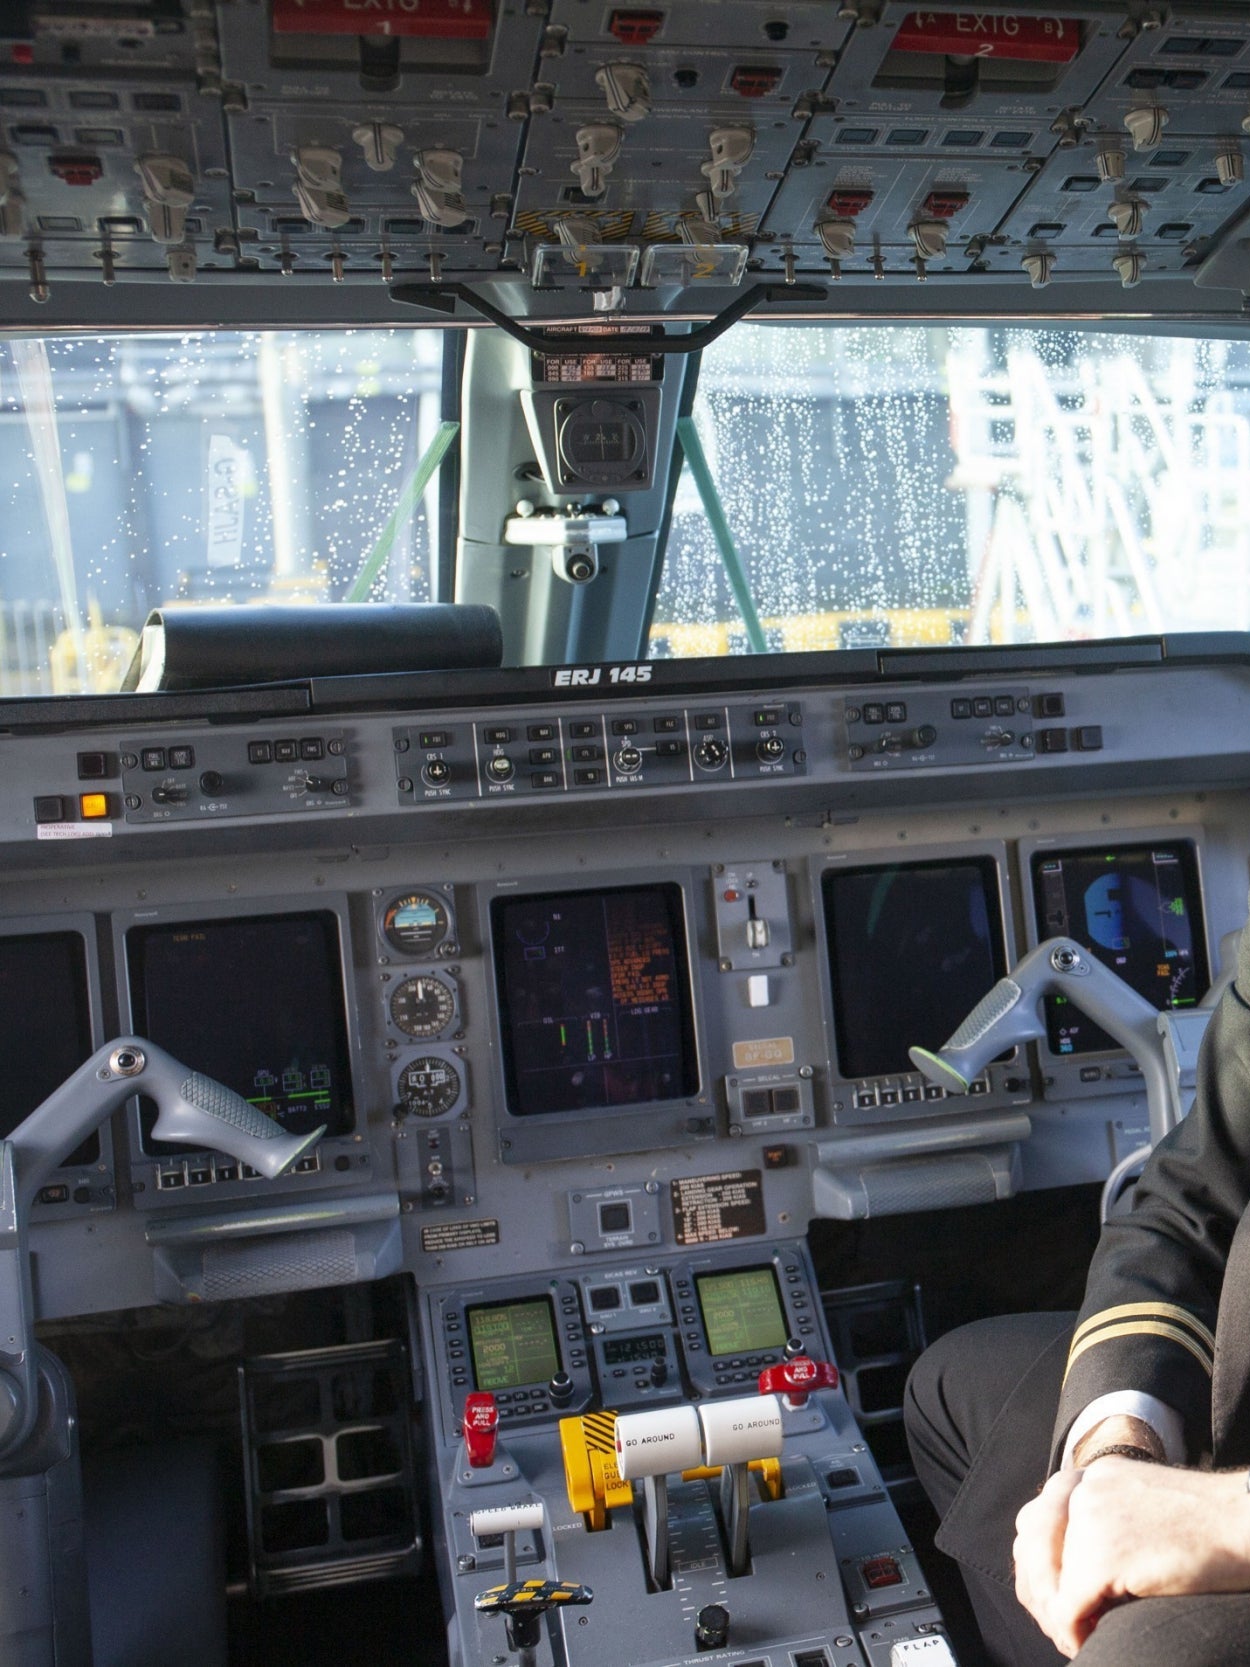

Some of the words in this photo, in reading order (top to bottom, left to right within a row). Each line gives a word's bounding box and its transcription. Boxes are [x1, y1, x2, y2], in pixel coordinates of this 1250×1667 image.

[376, 20, 391, 35] 1
[1044, 22, 1053, 33] B
[974, 44, 994, 57] 2
[574, 262, 586, 277] 1
[693, 263, 715, 278] 2
[554, 668, 601, 687] ERJ
[609, 666, 652, 683] 145
[679, 1175, 720, 1184] MANEUVERING
[483, 1343, 506, 1353] 2000
[472, 1406, 494, 1414] PRESS
[732, 1423, 743, 1431] GO
[748, 1418, 780, 1429] AROUND
[626, 1439, 637, 1447] GO
[641, 1433, 675, 1444] AROUND
[553, 1522, 582, 1532] LOCKED
[690, 1561, 706, 1569] IDLE
[683, 1655, 713, 1666] THRUST
[716, 1651, 745, 1661] RATING
